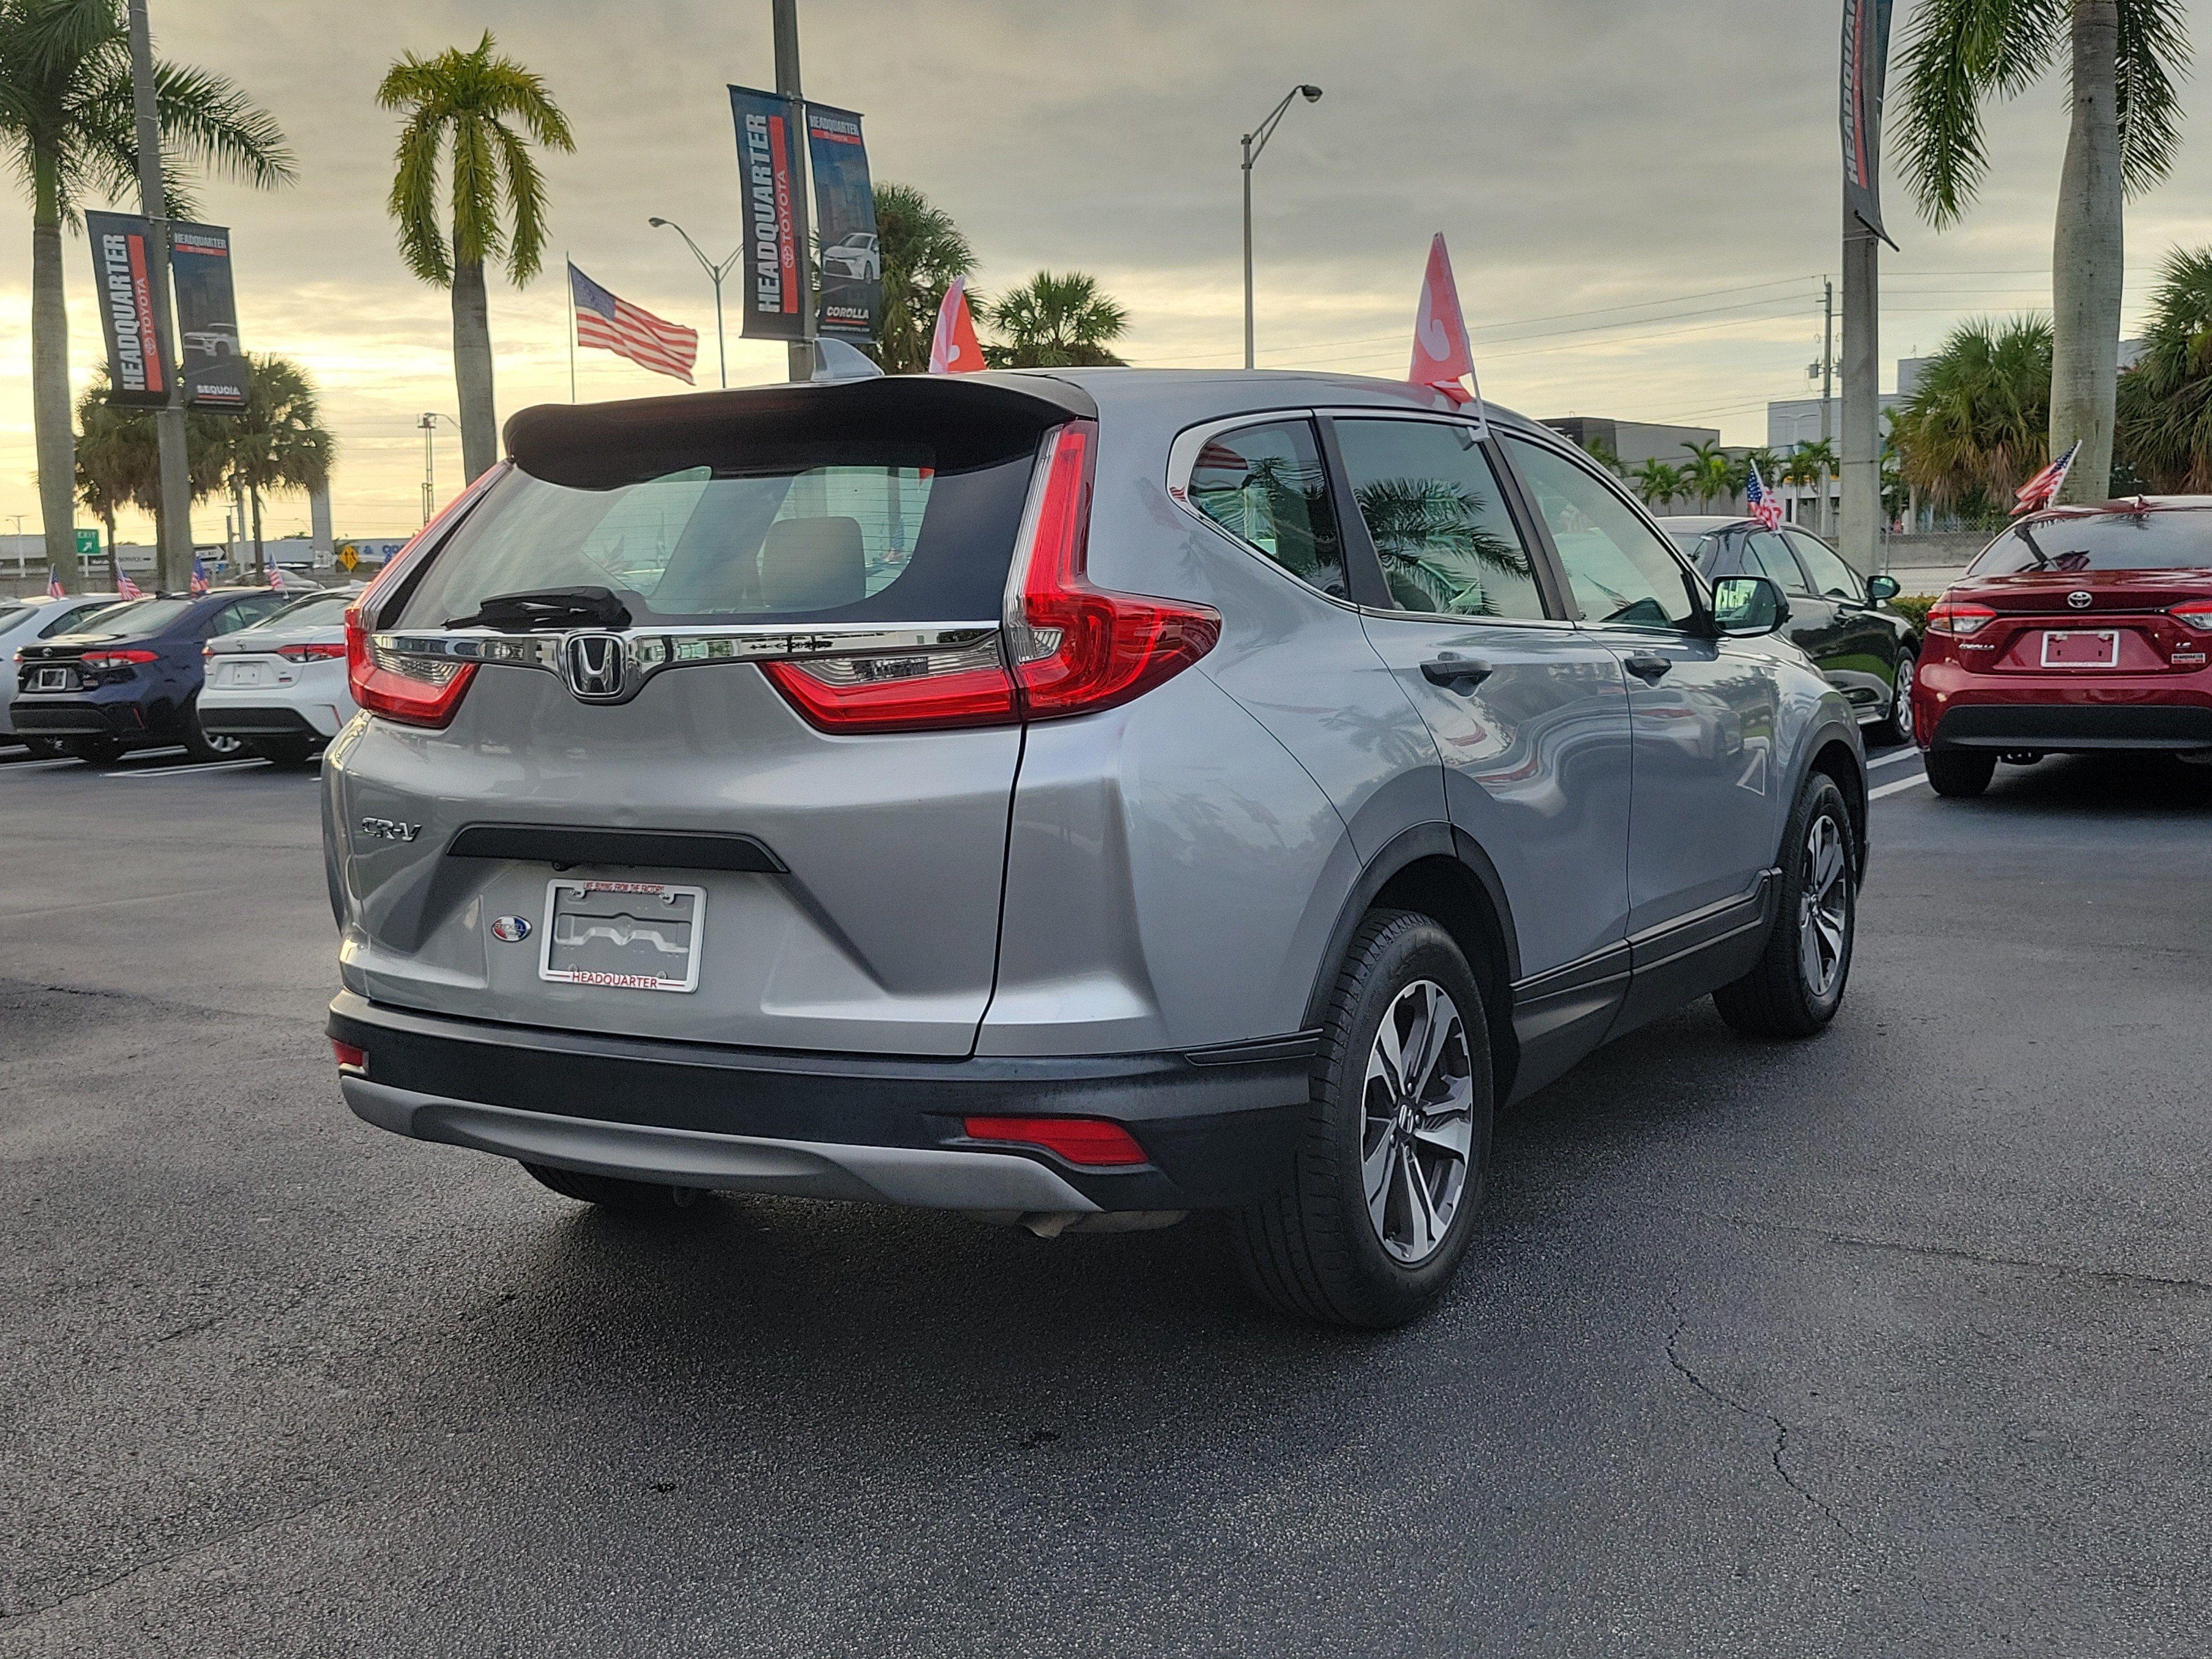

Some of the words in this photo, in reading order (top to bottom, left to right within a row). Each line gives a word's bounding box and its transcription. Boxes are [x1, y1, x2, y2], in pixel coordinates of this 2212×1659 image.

[809, 114, 859, 137] HEADQUARTER
[746, 114, 780, 313] HEADQUARTER
[777, 171, 792, 242] TOYOTA
[174, 233, 227, 249] HEADQUARTER
[103, 234, 145, 391] HEADQUARTER
[137, 278, 152, 335] TOYOTA
[826, 307, 869, 319] COROLLA
[197, 385, 241, 395] SEQUOIA
[362, 817, 422, 842] CR-V
[572, 972, 658, 988] HEADQUARTER
